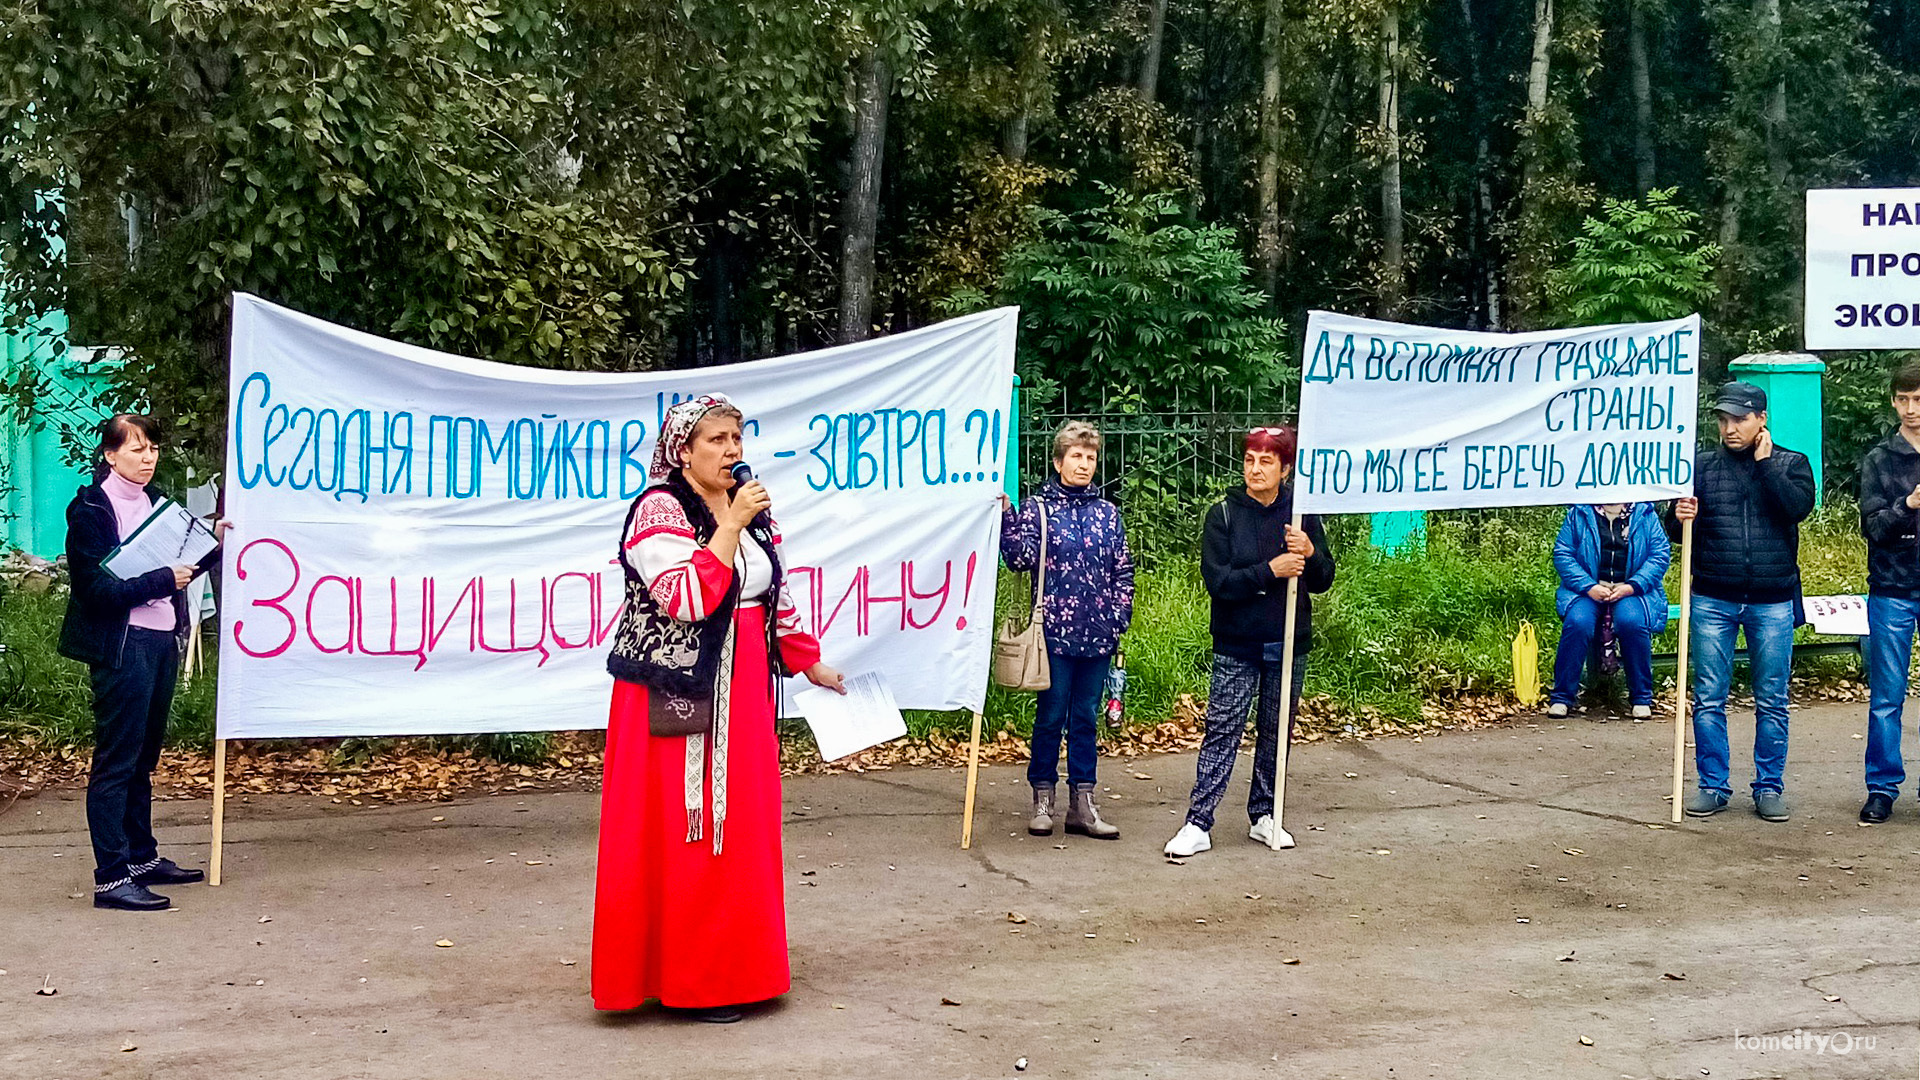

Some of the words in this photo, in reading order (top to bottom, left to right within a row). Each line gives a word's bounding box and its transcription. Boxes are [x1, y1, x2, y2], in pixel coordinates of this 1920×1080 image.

[1305, 331, 1355, 383] ДА
[1365, 337, 1532, 382] ВСПОМНЯТ
[1535, 330, 1693, 382] ГРАЖДАНЕ
[1545, 386, 1685, 434] СТРАНЫ,
[236, 372, 412, 504] Сегодня
[428, 414, 608, 499] помойка
[1299, 448, 1352, 494] ЧТО
[1363, 449, 1404, 493] МЫ
[1414, 441, 1449, 492] ЕЁ
[1463, 444, 1565, 490] БЕРЕЧЬ
